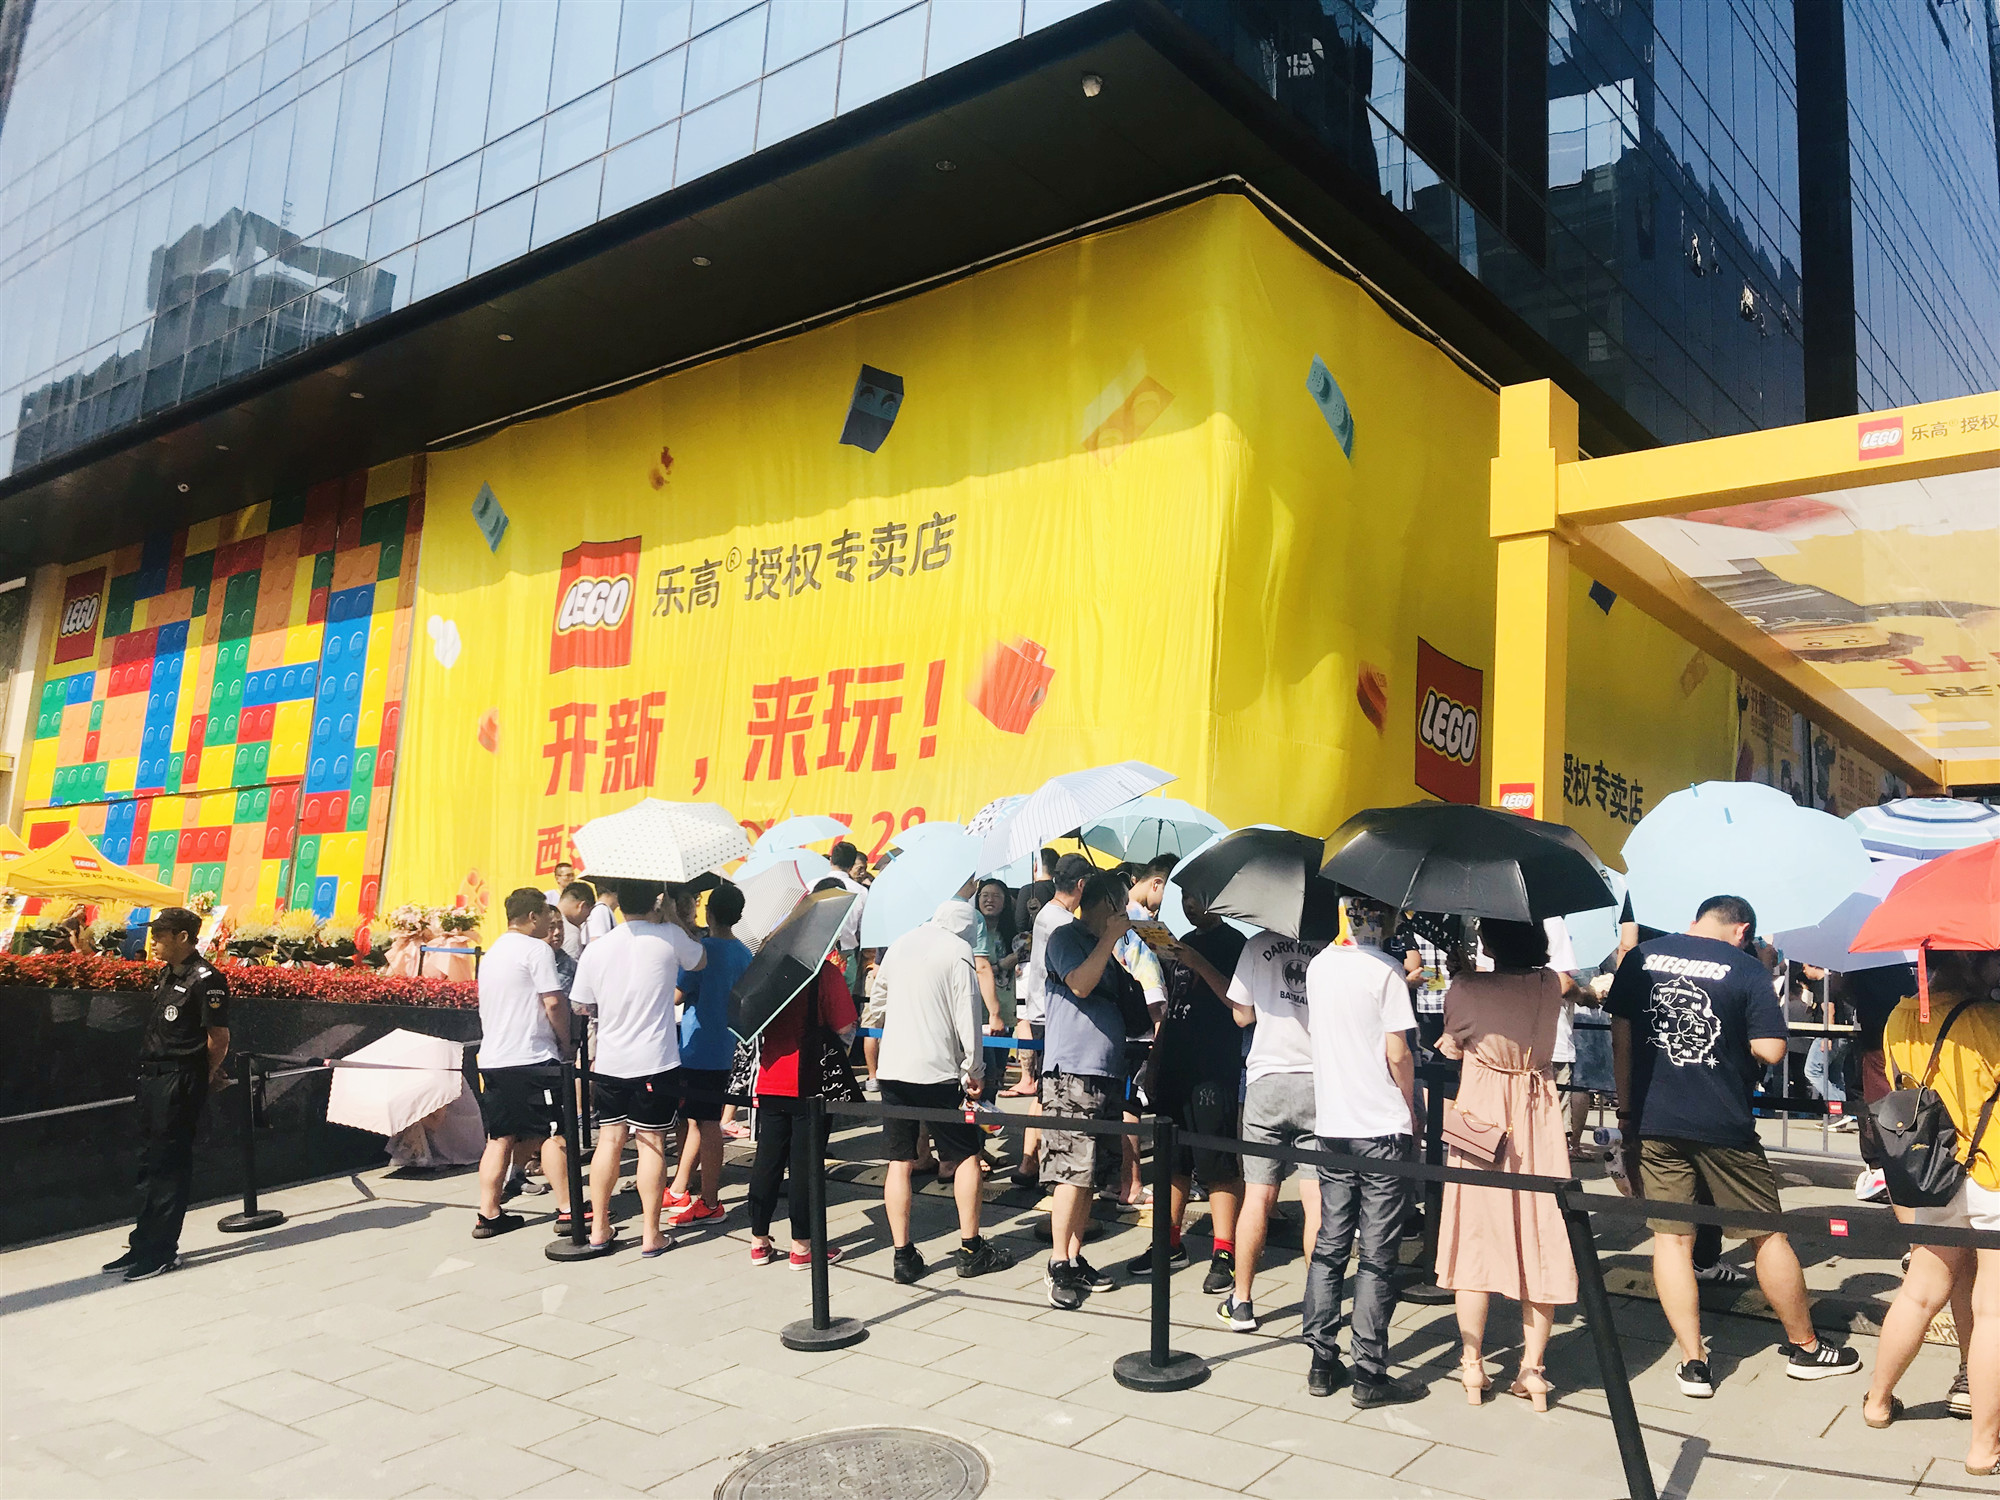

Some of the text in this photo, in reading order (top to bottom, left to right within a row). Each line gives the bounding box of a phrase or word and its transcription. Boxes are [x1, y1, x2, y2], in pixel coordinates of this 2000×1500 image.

[1860, 427, 1902, 450] LEGO
[61, 594, 100, 637] LEGO
[556, 575, 633, 636] LEGO
[1419, 686, 1479, 766] LEGO
[1501, 792, 1534, 809] LEGO
[1262, 941, 1295, 962] DARK
[1641, 954, 1732, 980] SKECHERS
